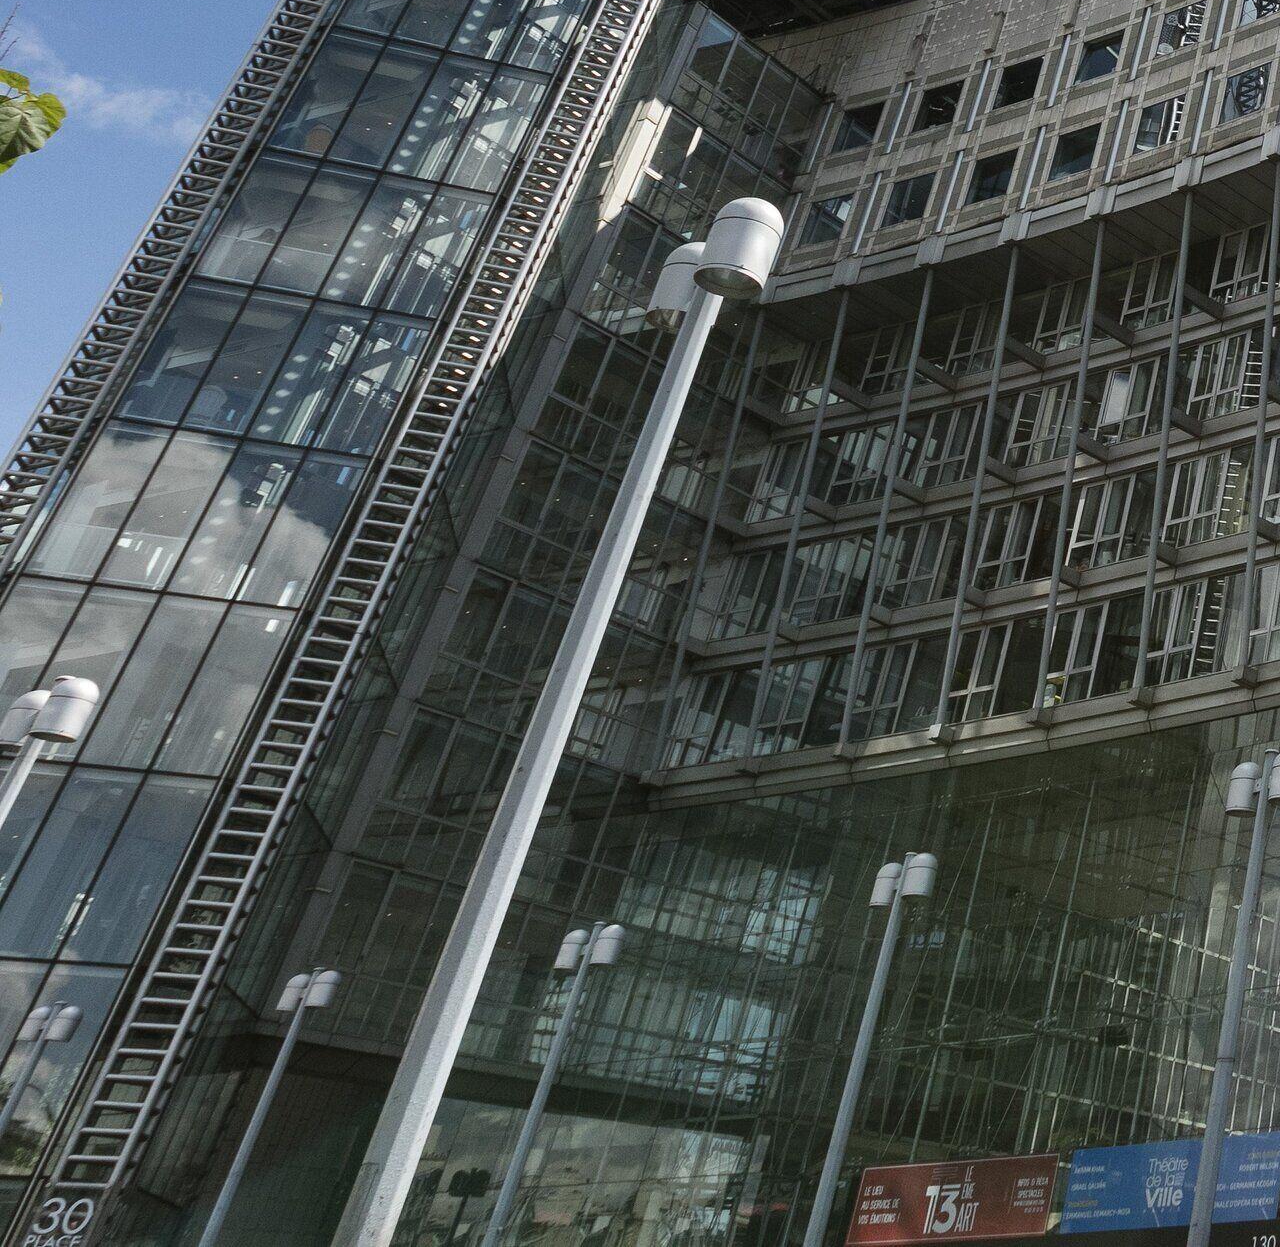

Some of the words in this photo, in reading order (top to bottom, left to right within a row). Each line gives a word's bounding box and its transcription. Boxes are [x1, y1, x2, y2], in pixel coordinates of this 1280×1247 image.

[965, 1165, 975, 1182] LE
[1149, 1156, 1189, 1173] Théâtre
[1146, 1172, 1161, 1188] de
[1163, 1171, 1175, 1187] la
[1145, 1187, 1183, 1208] Ville
[33, 1197, 95, 1235] 30
[923, 1183, 961, 1234] 13
[954, 1202, 980, 1232] ART
[23, 1235, 83, 1247] PLACE
